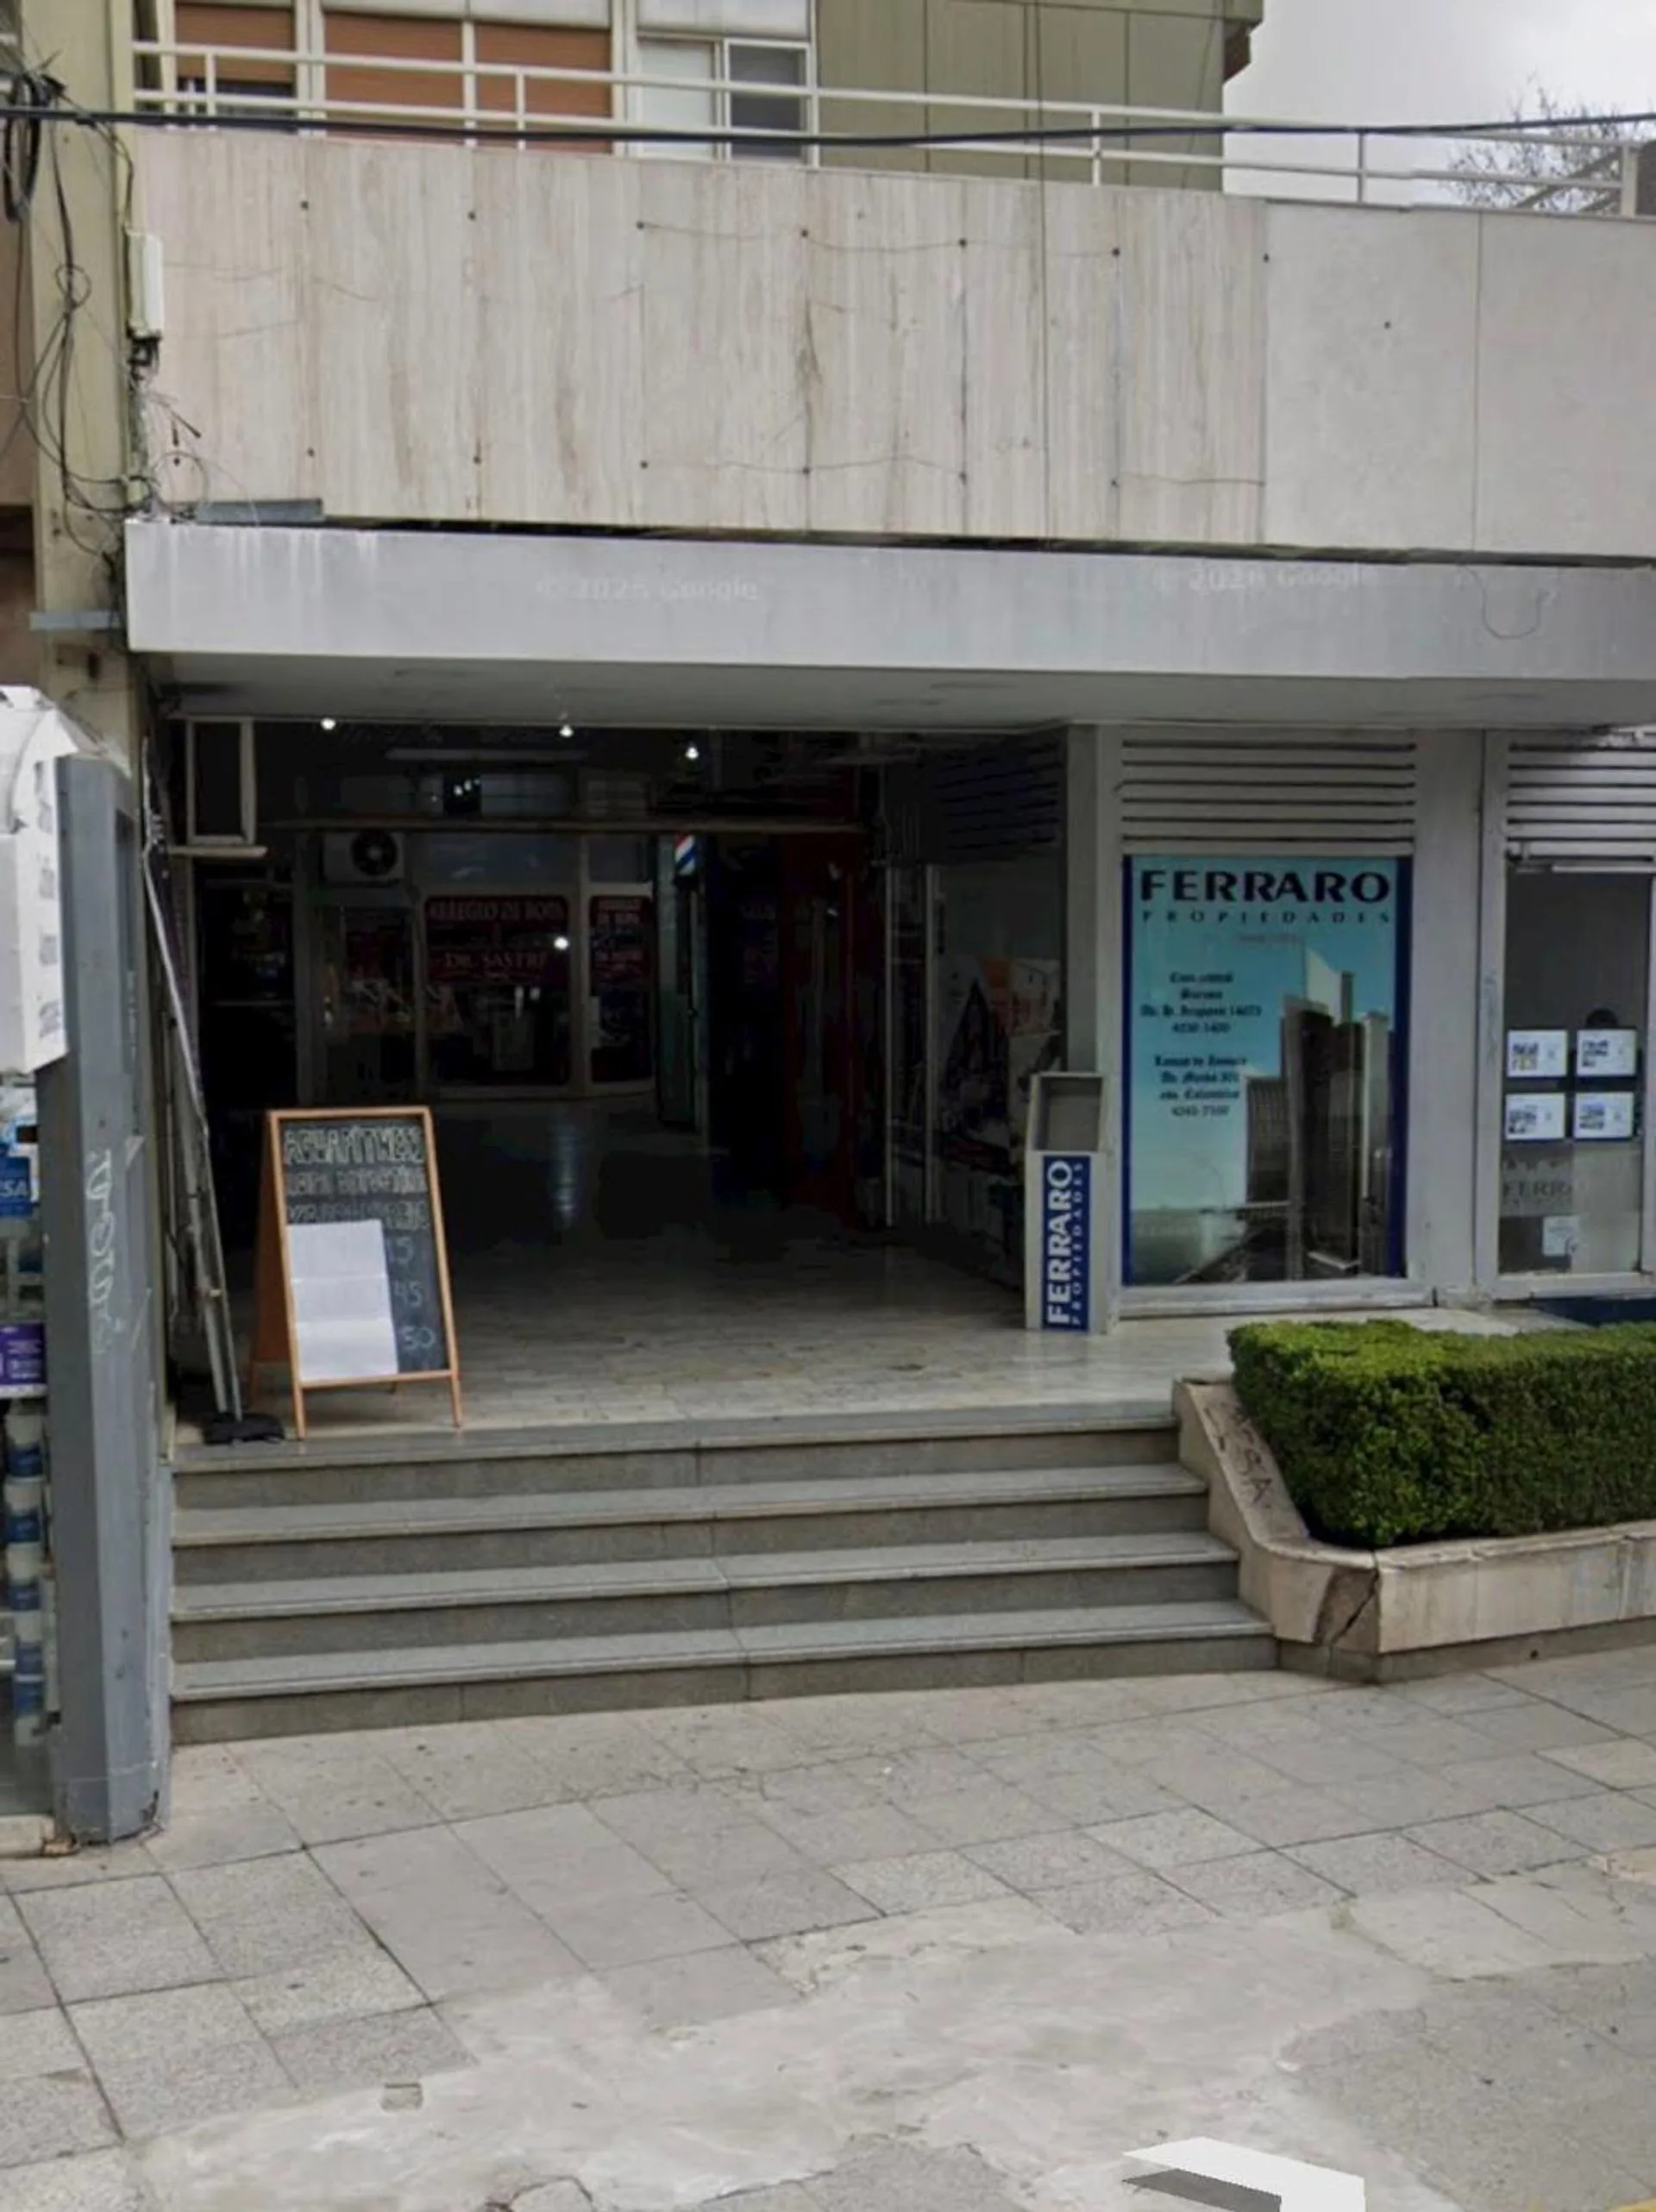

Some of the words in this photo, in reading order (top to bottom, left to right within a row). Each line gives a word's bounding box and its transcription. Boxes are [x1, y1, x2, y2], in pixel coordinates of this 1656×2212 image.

[1140, 869, 1390, 903] FERRARO
[1142, 910, 1390, 924] PROPIEDADES
[1046, 1159, 1073, 1324] FERRARO
[1072, 1162, 1083, 1325] PROPIEDADES
